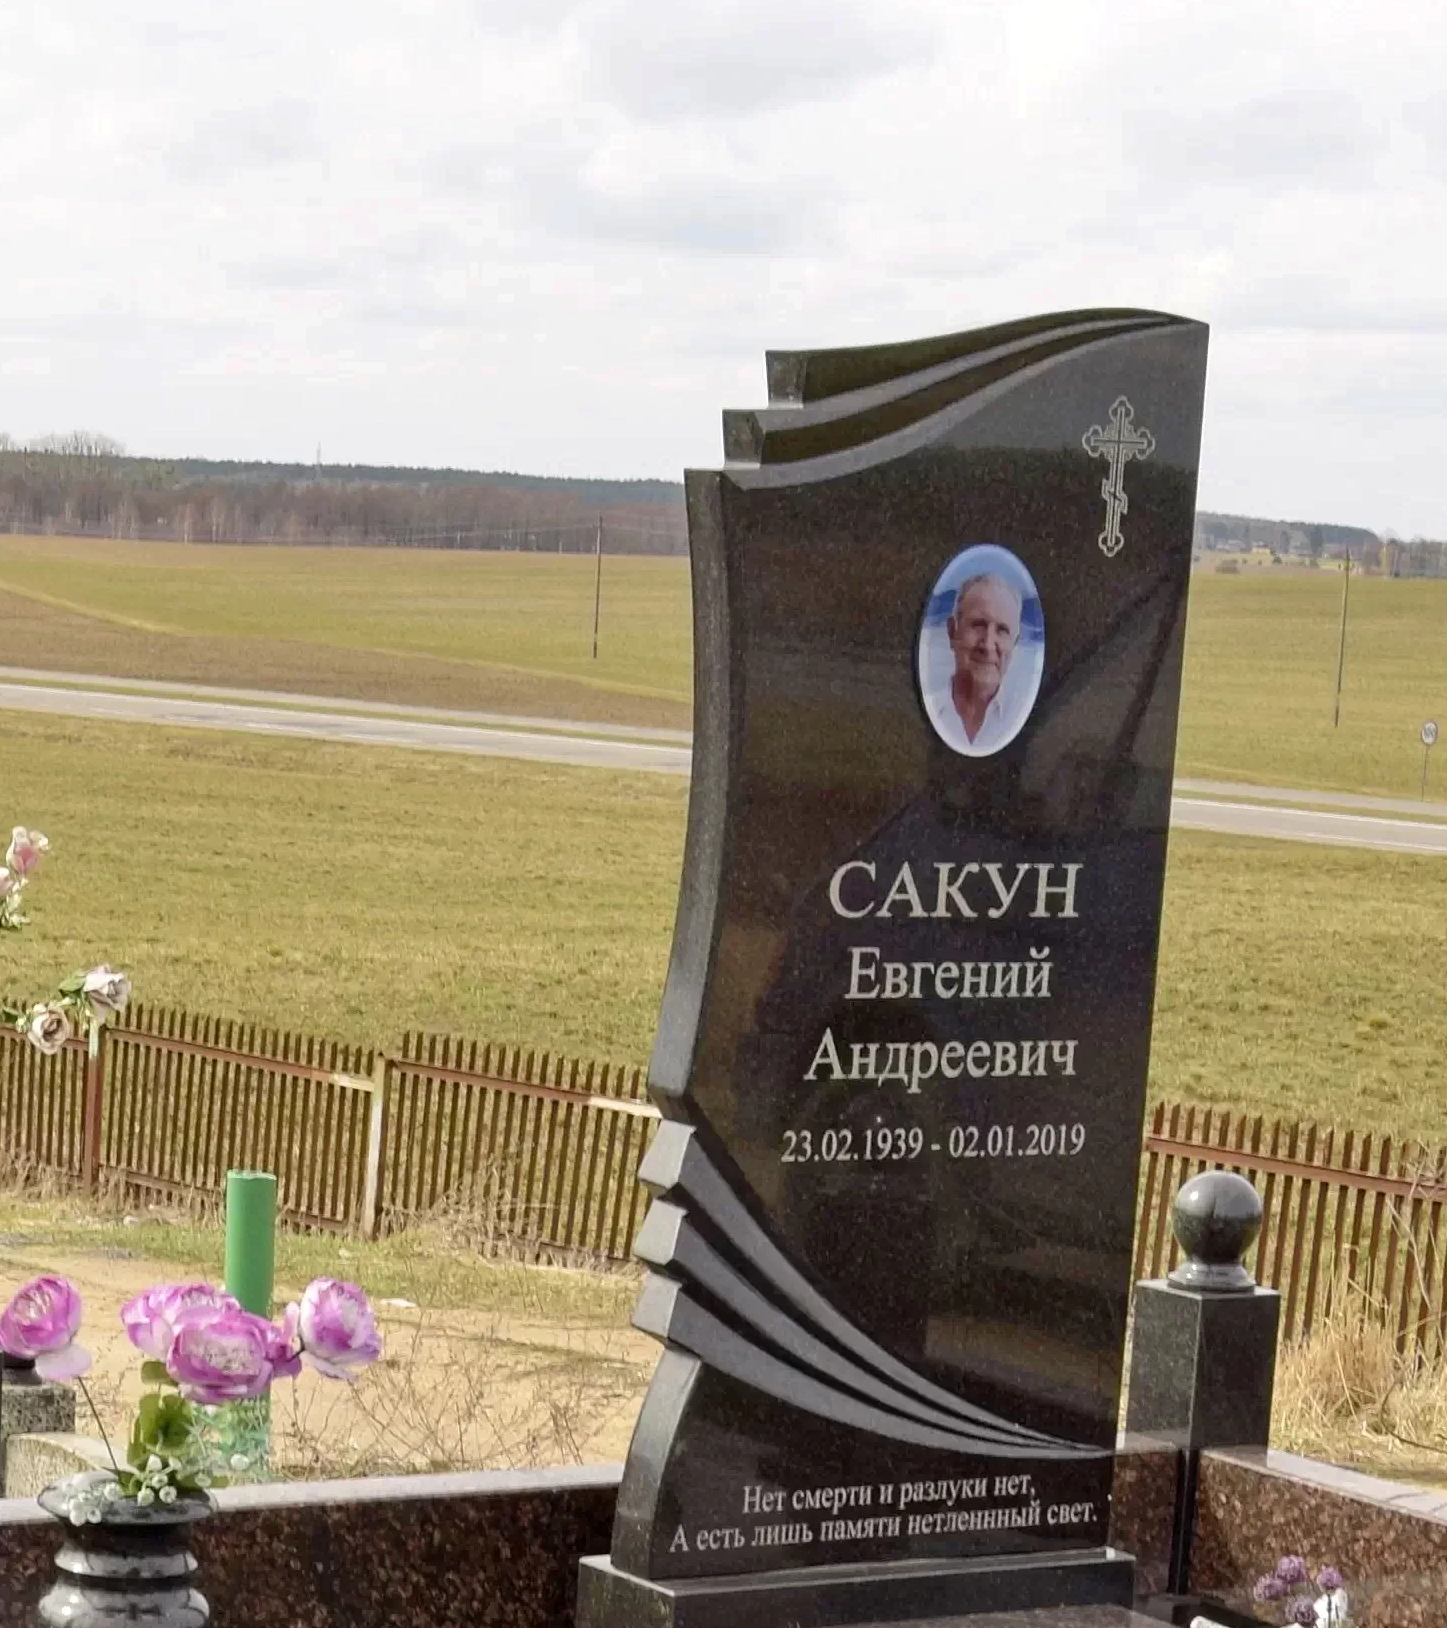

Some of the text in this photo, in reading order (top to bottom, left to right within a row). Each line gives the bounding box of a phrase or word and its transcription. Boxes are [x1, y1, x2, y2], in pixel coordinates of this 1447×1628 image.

[829, 860, 1084, 919] САКУН
[844, 946, 1054, 1000] Евгений
[803, 1027, 1079, 1094] Андреевич
[780, 1127, 924, 1163] 23.02.1939
[949, 1123, 1086, 1158] 02.01.2019
[742, 1473, 1037, 1517] Нет смерти и разлуки нет,
[669, 1524, 689, 1553] А
[695, 1525, 746, 1552] есть
[752, 1521, 814, 1549] лишь
[820, 1515, 902, 1542] памяти
[1046, 1500, 1099, 1526] свет.
